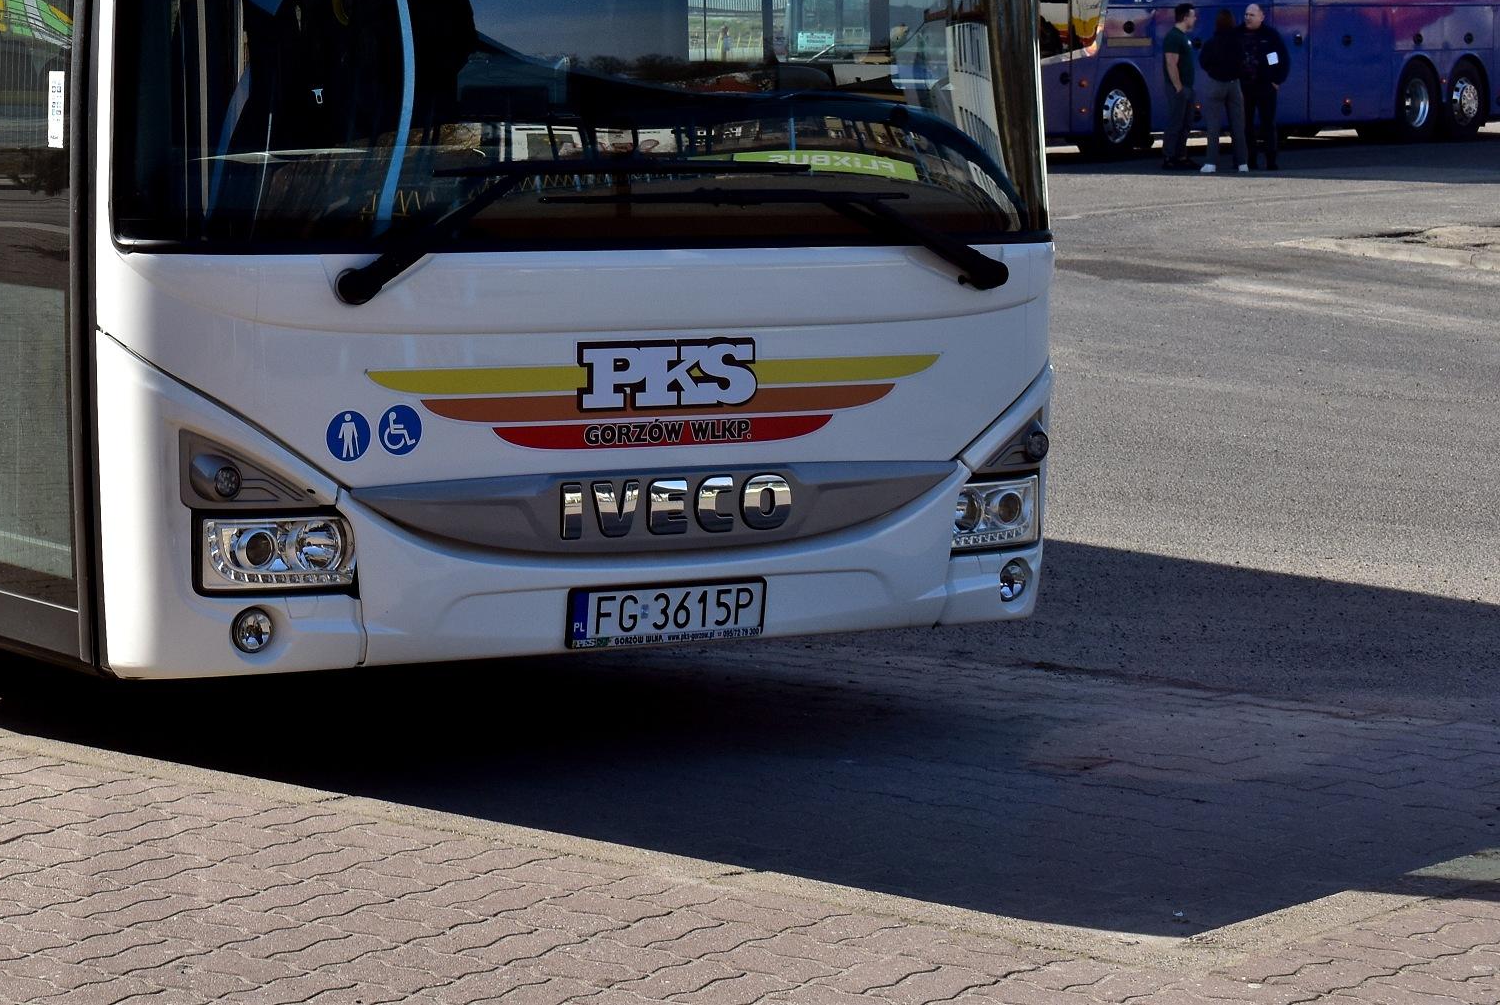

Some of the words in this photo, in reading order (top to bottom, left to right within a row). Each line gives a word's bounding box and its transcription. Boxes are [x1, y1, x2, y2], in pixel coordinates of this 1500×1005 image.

[578, 338, 758, 412] PKS
[584, 418, 684, 445] GORZÓW
[690, 419, 752, 441] WLKP.
[560, 472, 792, 540] IVECO
[573, 622, 585, 633] PL
[595, 594, 639, 634] FG
[652, 587, 754, 630] 3615P
